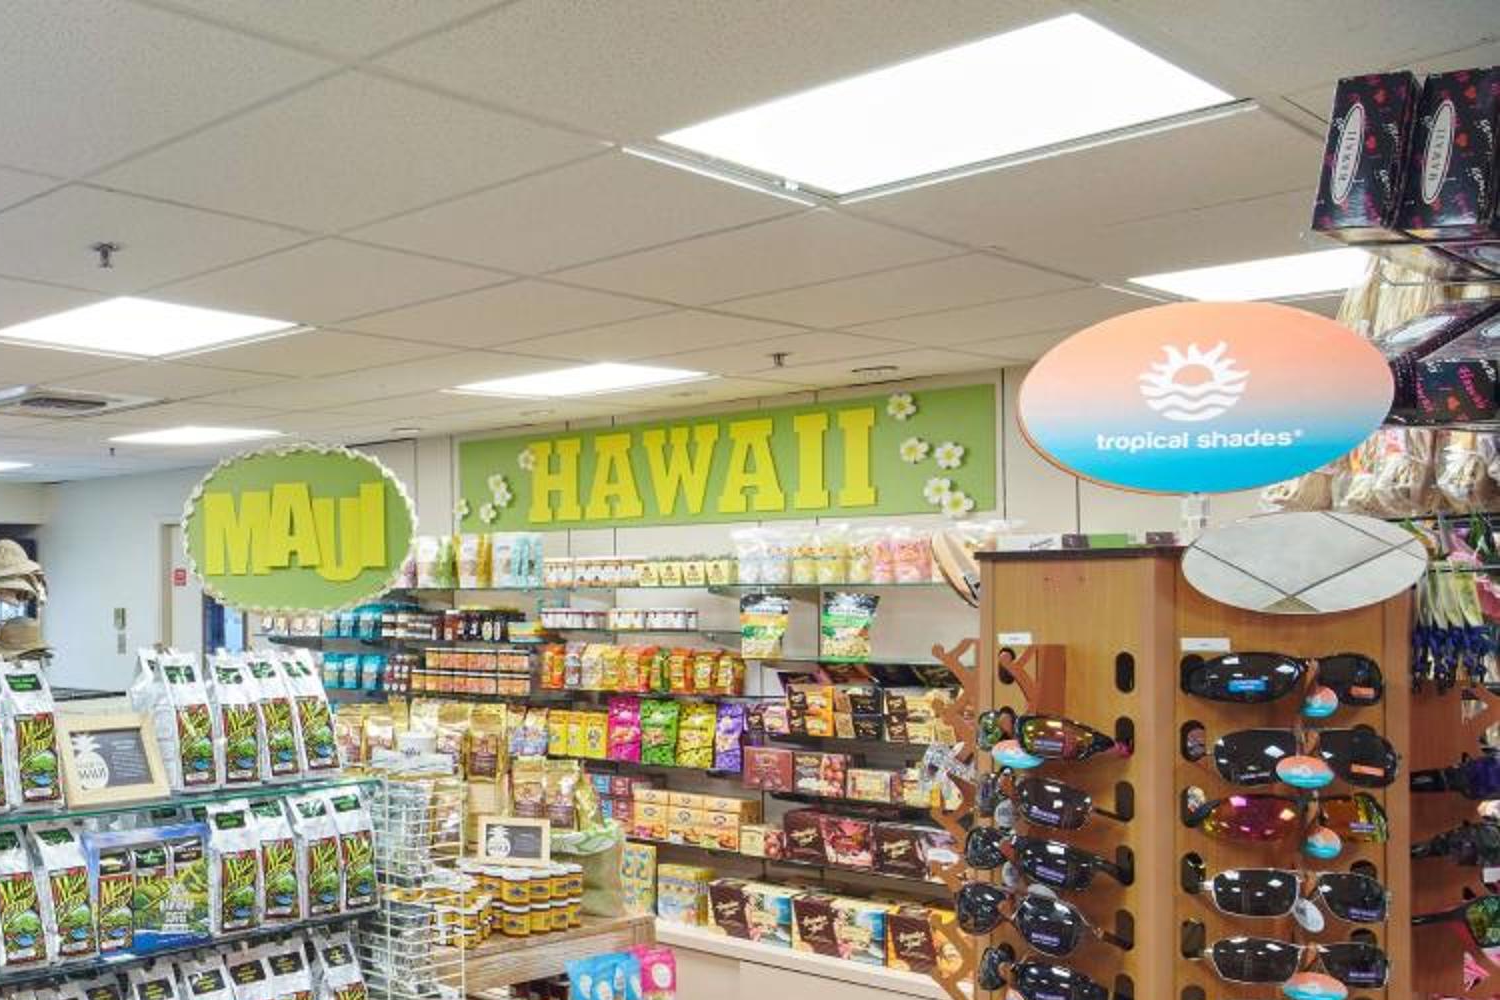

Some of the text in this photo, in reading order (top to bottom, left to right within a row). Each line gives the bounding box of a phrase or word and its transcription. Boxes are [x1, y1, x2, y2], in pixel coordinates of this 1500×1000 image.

[527, 406, 879, 523] HAWAII
[1096, 431, 1188, 453] tropical
[203, 481, 387, 582] MAUI
